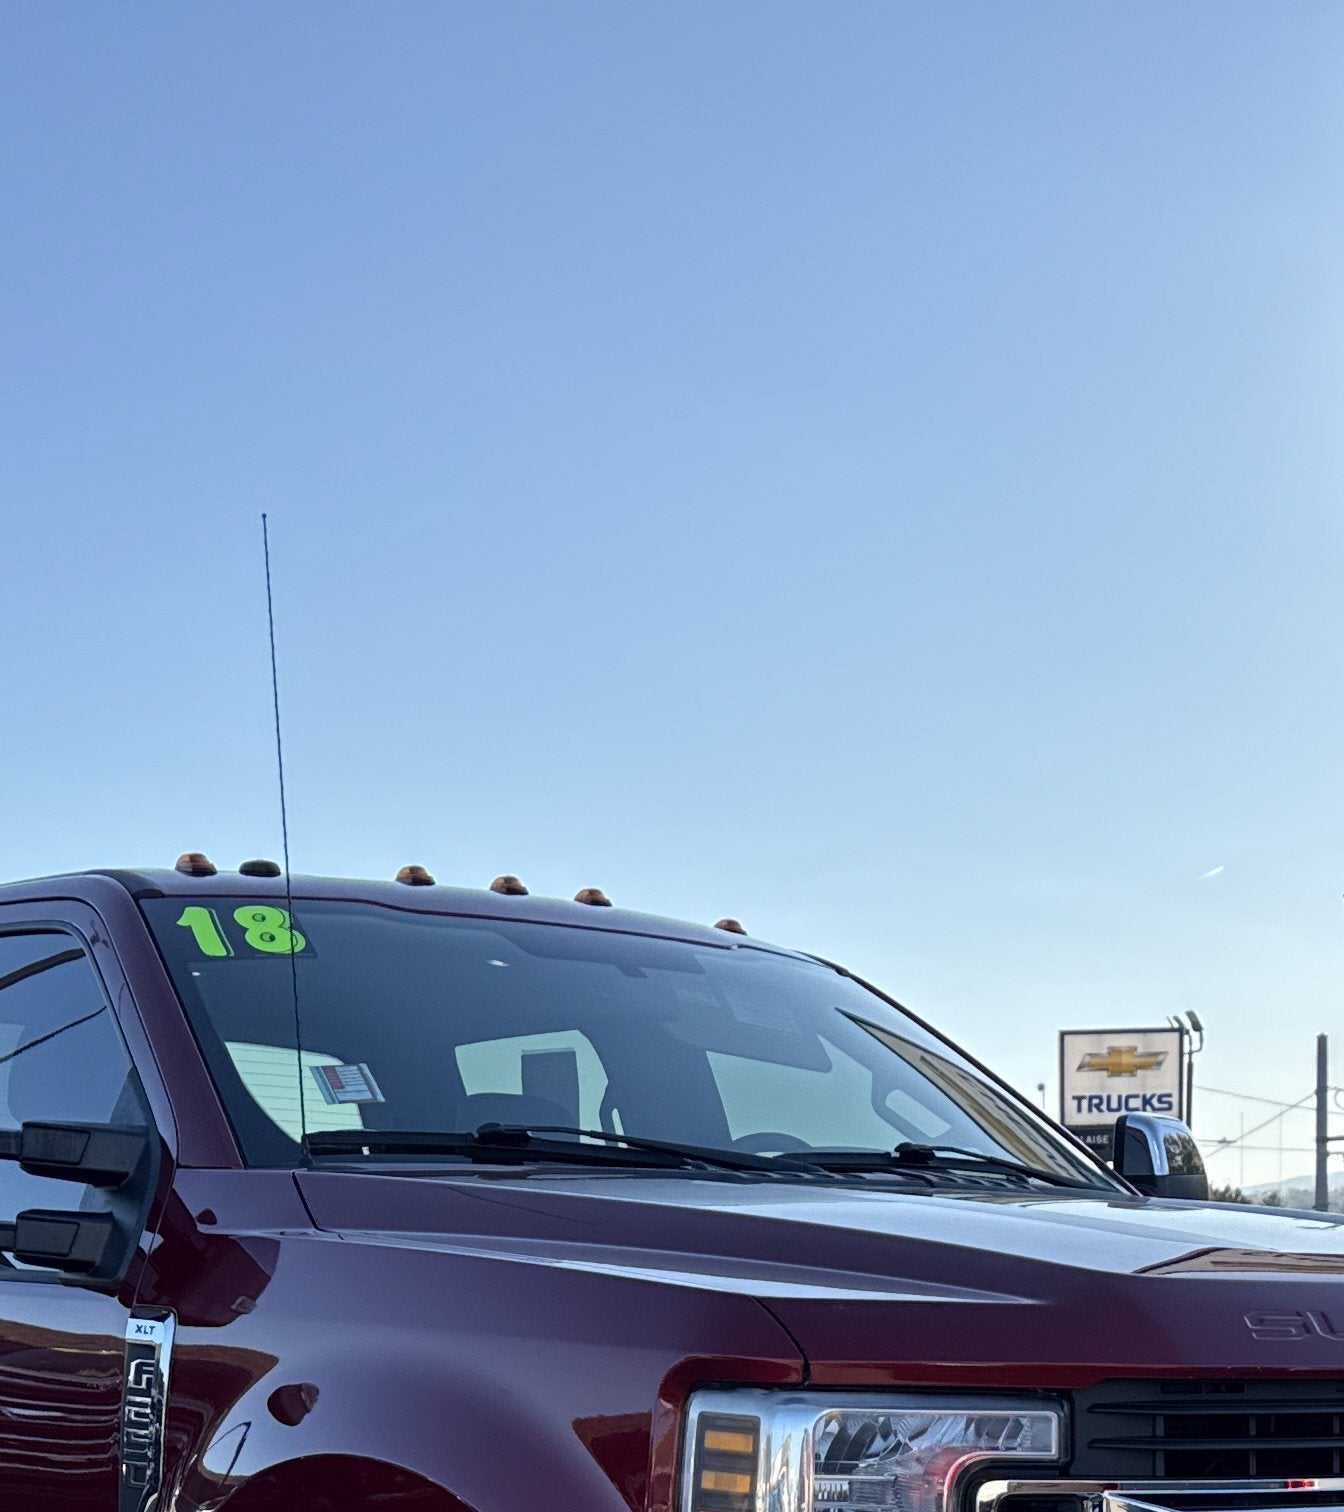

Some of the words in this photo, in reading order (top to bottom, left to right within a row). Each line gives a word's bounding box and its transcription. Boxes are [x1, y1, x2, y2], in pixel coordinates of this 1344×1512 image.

[176, 905, 307, 957] 18
[1072, 1092, 1174, 1113] TRUCKS
[134, 1324, 156, 1336] XLT
